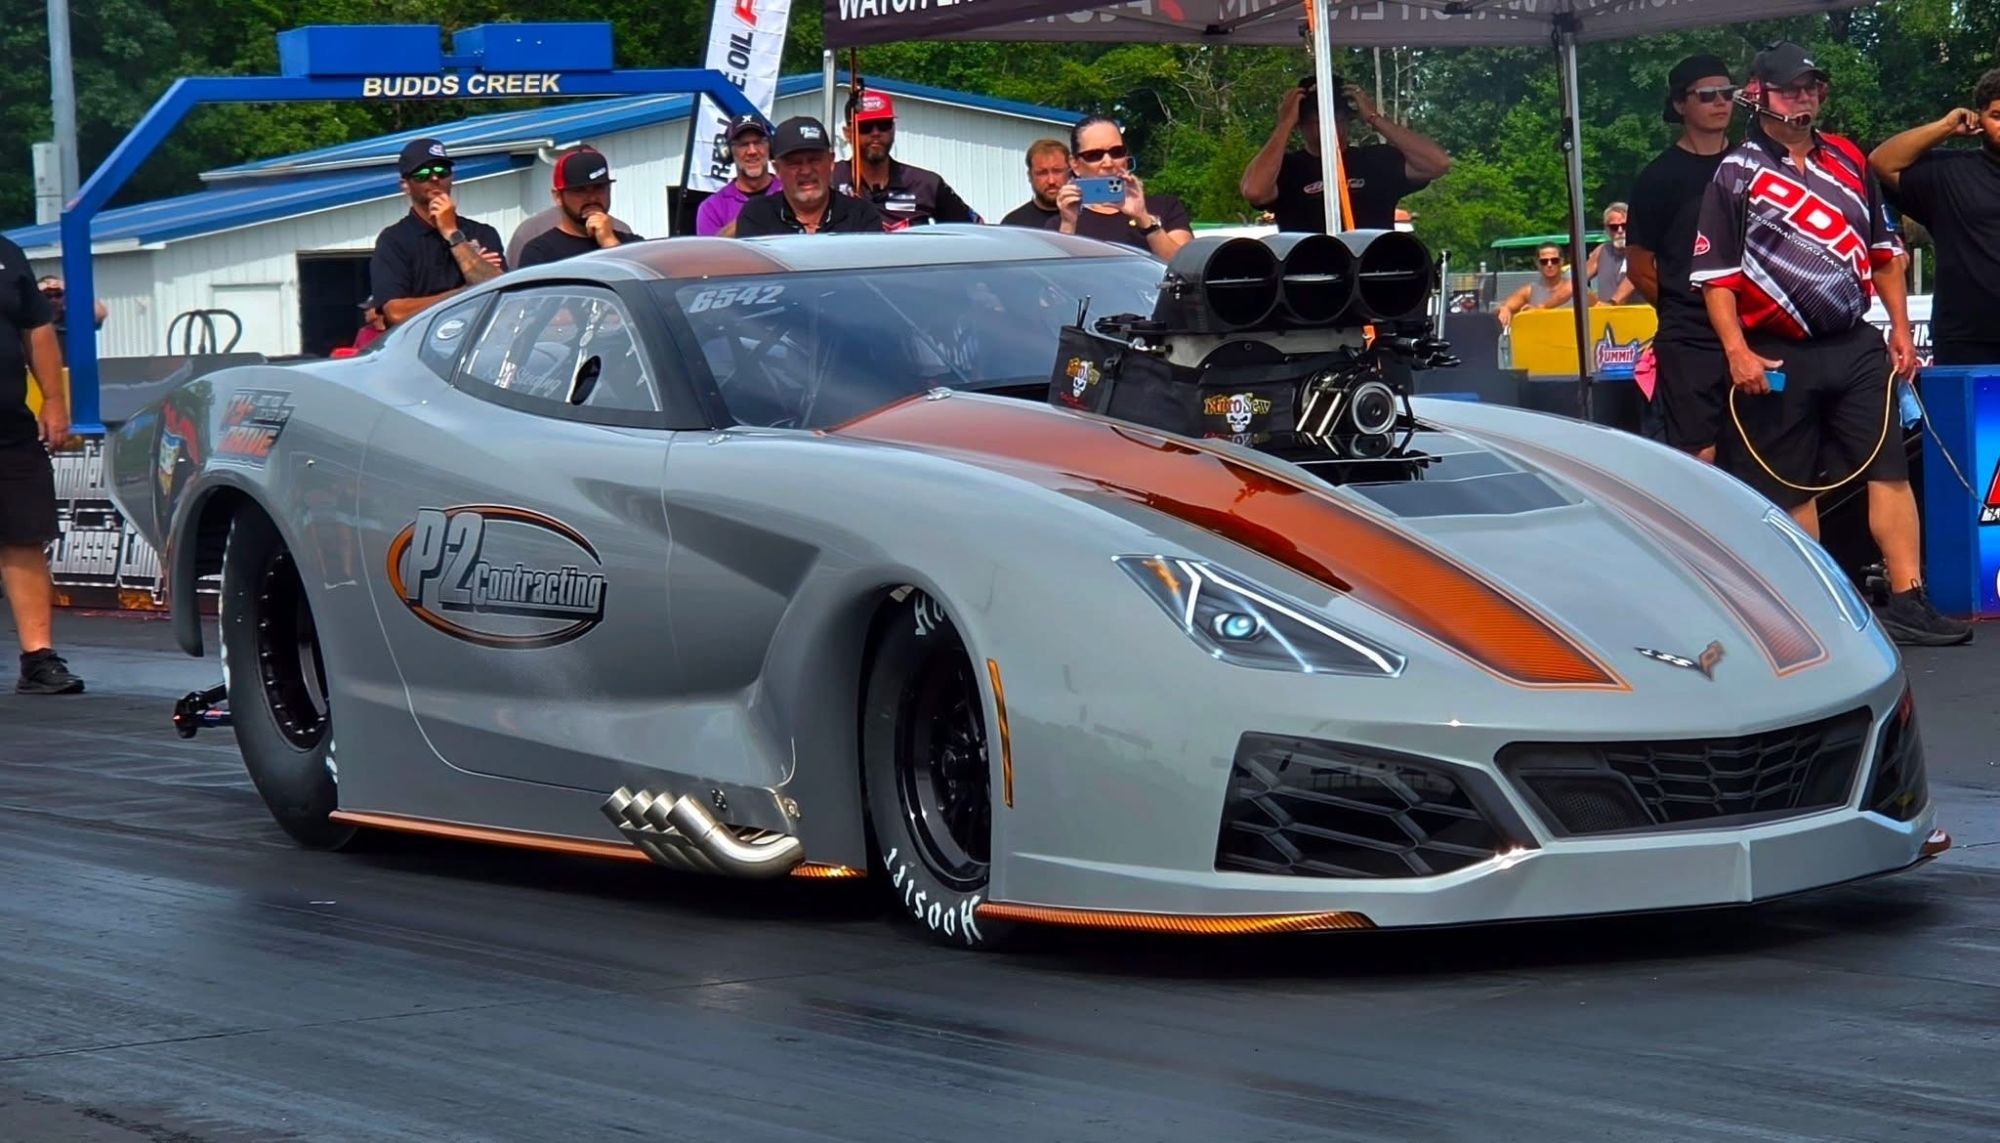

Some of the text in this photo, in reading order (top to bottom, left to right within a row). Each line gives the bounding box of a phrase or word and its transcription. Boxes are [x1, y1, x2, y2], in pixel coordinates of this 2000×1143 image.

[363, 74, 561, 97] BUDDS CREEK
[688, 285, 785, 313] 6542
[1596, 342, 1635, 369] SUMMIT
[406, 508, 604, 614] P2 Contracting
